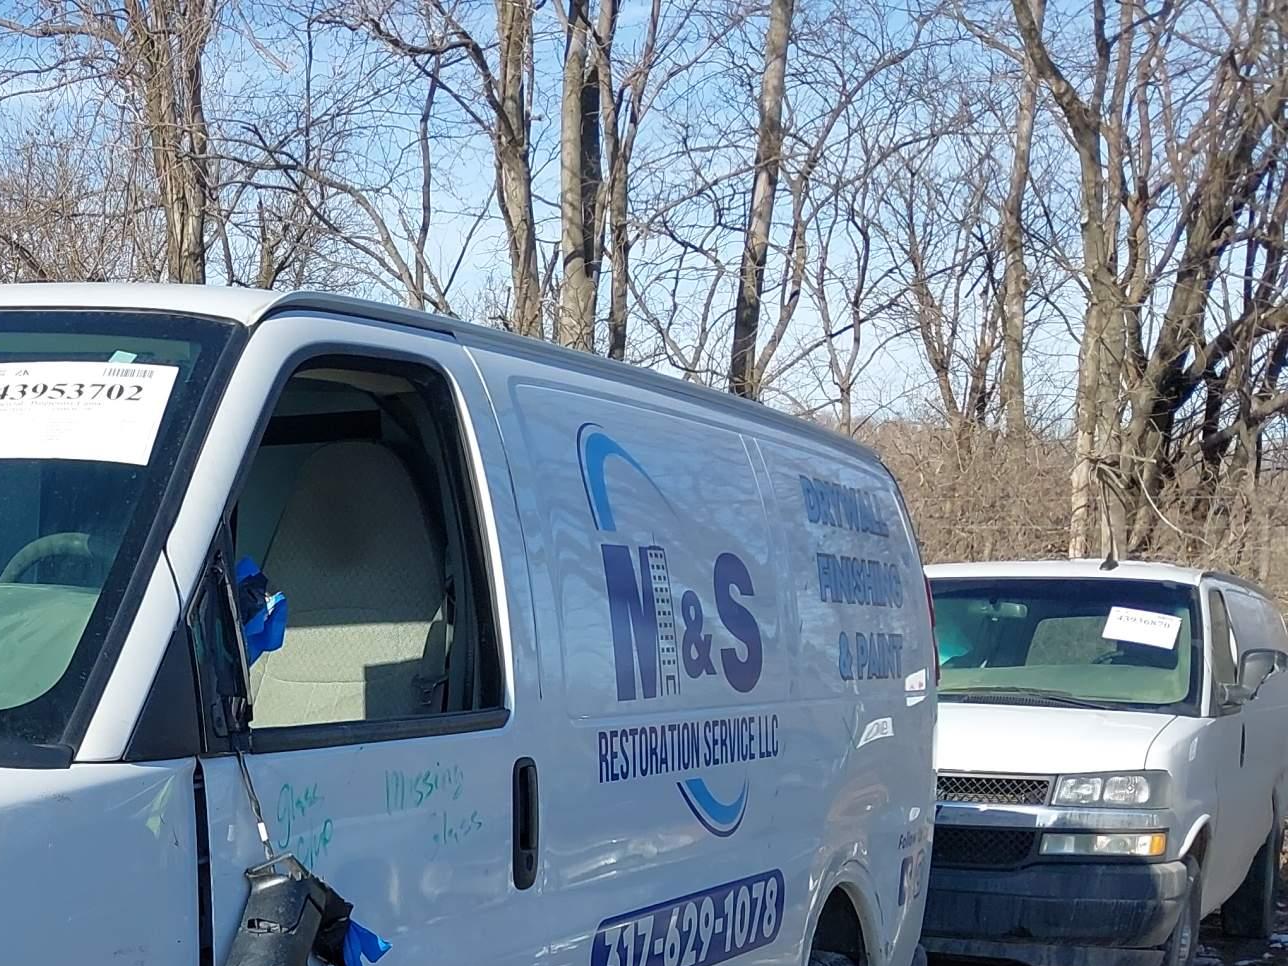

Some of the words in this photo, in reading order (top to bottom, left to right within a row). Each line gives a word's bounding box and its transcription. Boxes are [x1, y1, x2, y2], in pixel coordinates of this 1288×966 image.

[799, 475, 889, 538] DRYWALL
[816, 552, 904, 609] FINISHING
[838, 631, 854, 681] &
[855, 632, 903, 680] PAINT
[598, 722, 700, 783] RESTORATION
[703, 716, 755, 767] SERVICE
[758, 714, 779, 759] LLC
